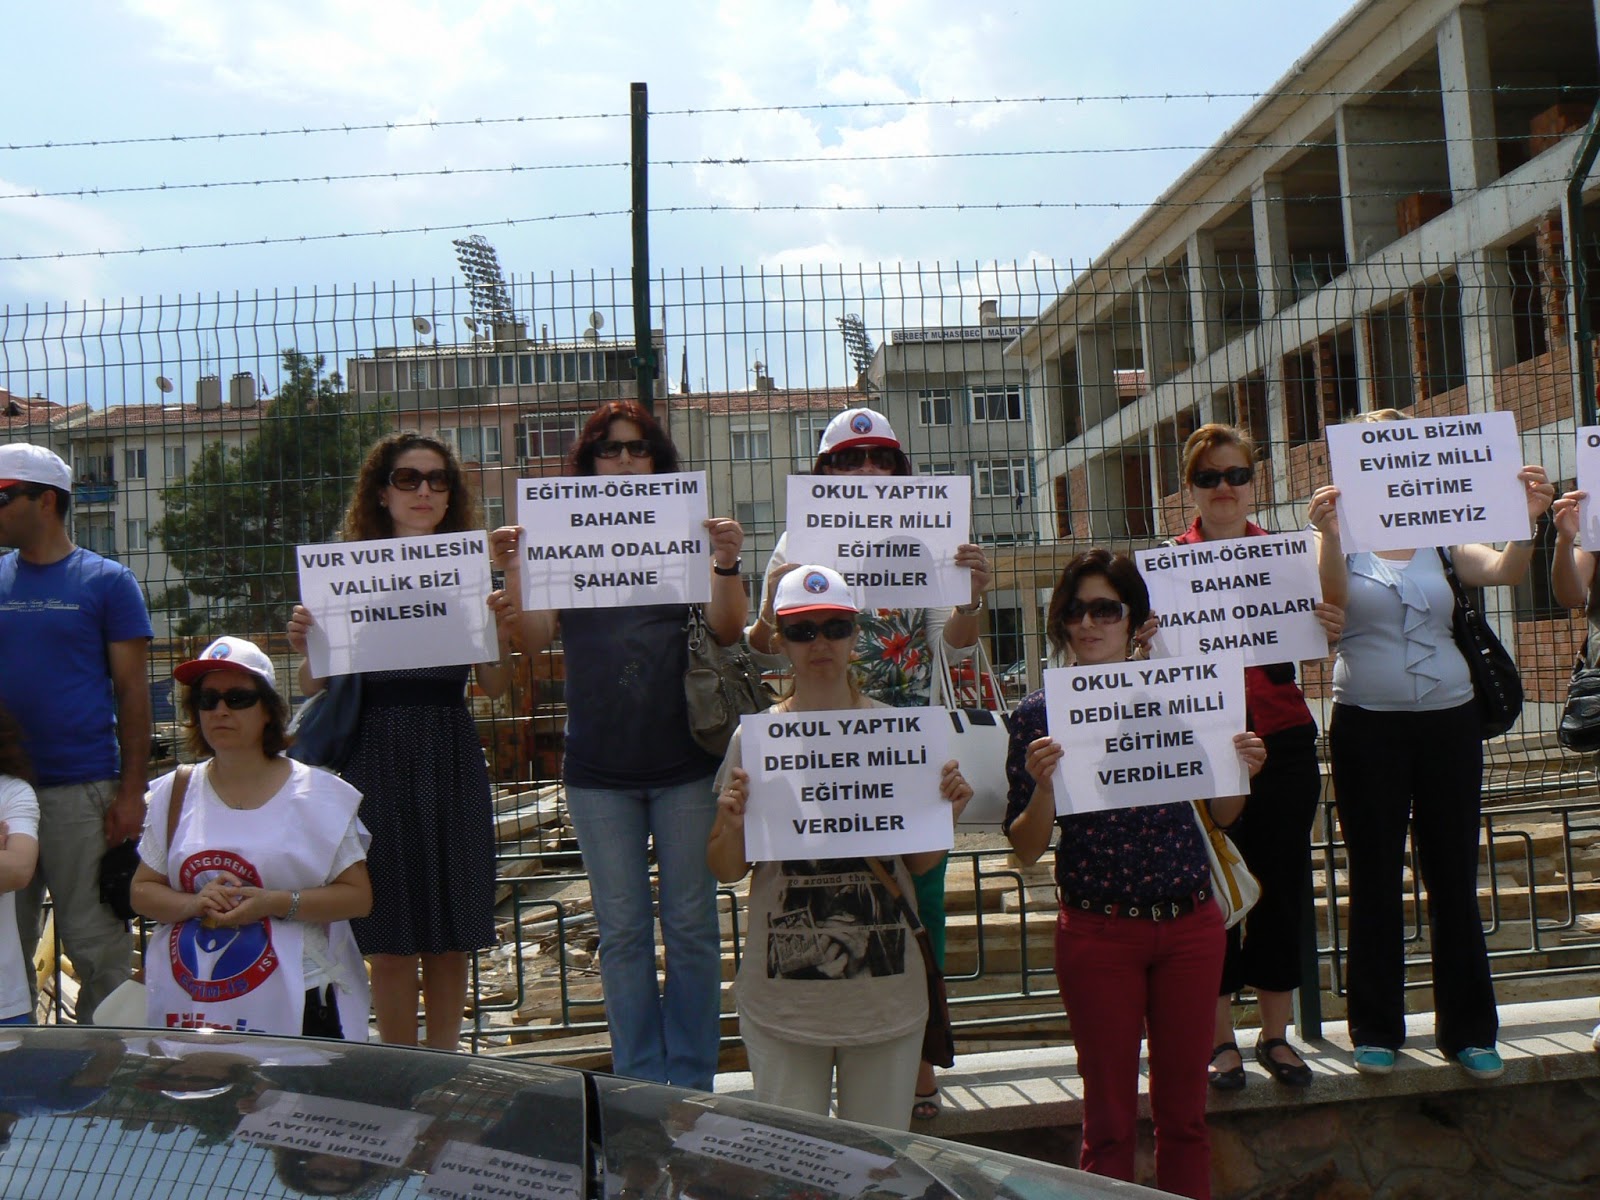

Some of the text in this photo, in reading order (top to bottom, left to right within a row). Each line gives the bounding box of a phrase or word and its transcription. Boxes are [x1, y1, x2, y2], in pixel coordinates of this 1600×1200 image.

[893, 331, 929, 340] SERBEST
[931, 329, 982, 339] MUHASEBEC
[1361, 420, 1482, 444] OKUL BİZİM
[1360, 445, 1492, 471] EVİMİZ MİLLİ
[526, 479, 698, 501] EĞİTİM-ÖĞRETİM
[811, 485, 948, 499] OKUL YAPTIK
[1388, 477, 1472, 498] EĞİTİME
[571, 511, 656, 527] BAHANE
[807, 511, 951, 529] DEDİLER MİLLİ
[1379, 504, 1486, 528] VERMEYİZ
[302, 538, 484, 569] VUR VUR İNLESİN
[527, 540, 701, 561] MAKAM ODALARI
[838, 541, 920, 558] EĞİTİME
[1144, 539, 1307, 572] EĞİTİM-ÖĞRETİM
[331, 568, 460, 596] VALİLİK BİZİ
[574, 571, 658, 590] ŞAHANE
[1191, 572, 1271, 594] BAHANE
[351, 601, 447, 623] DİNLESİN
[1155, 597, 1316, 628] MAKAM ODALARI
[1199, 631, 1278, 654] ŞAHANE
[1072, 664, 1218, 692] OKUL YAPTIK
[1070, 691, 1224, 725] DEDİLER MİLLİ
[768, 717, 921, 739] OKUL YAPTIK
[1105, 730, 1193, 753] EĞİTİME
[765, 745, 926, 771] DEDİLER MİLLİ
[1098, 761, 1203, 785] VERDİLER
[801, 781, 894, 802] EĞİTİME
[792, 814, 904, 835] VERDİLER
[803, 875, 842, 885] around
[848, 874, 866, 883] the
